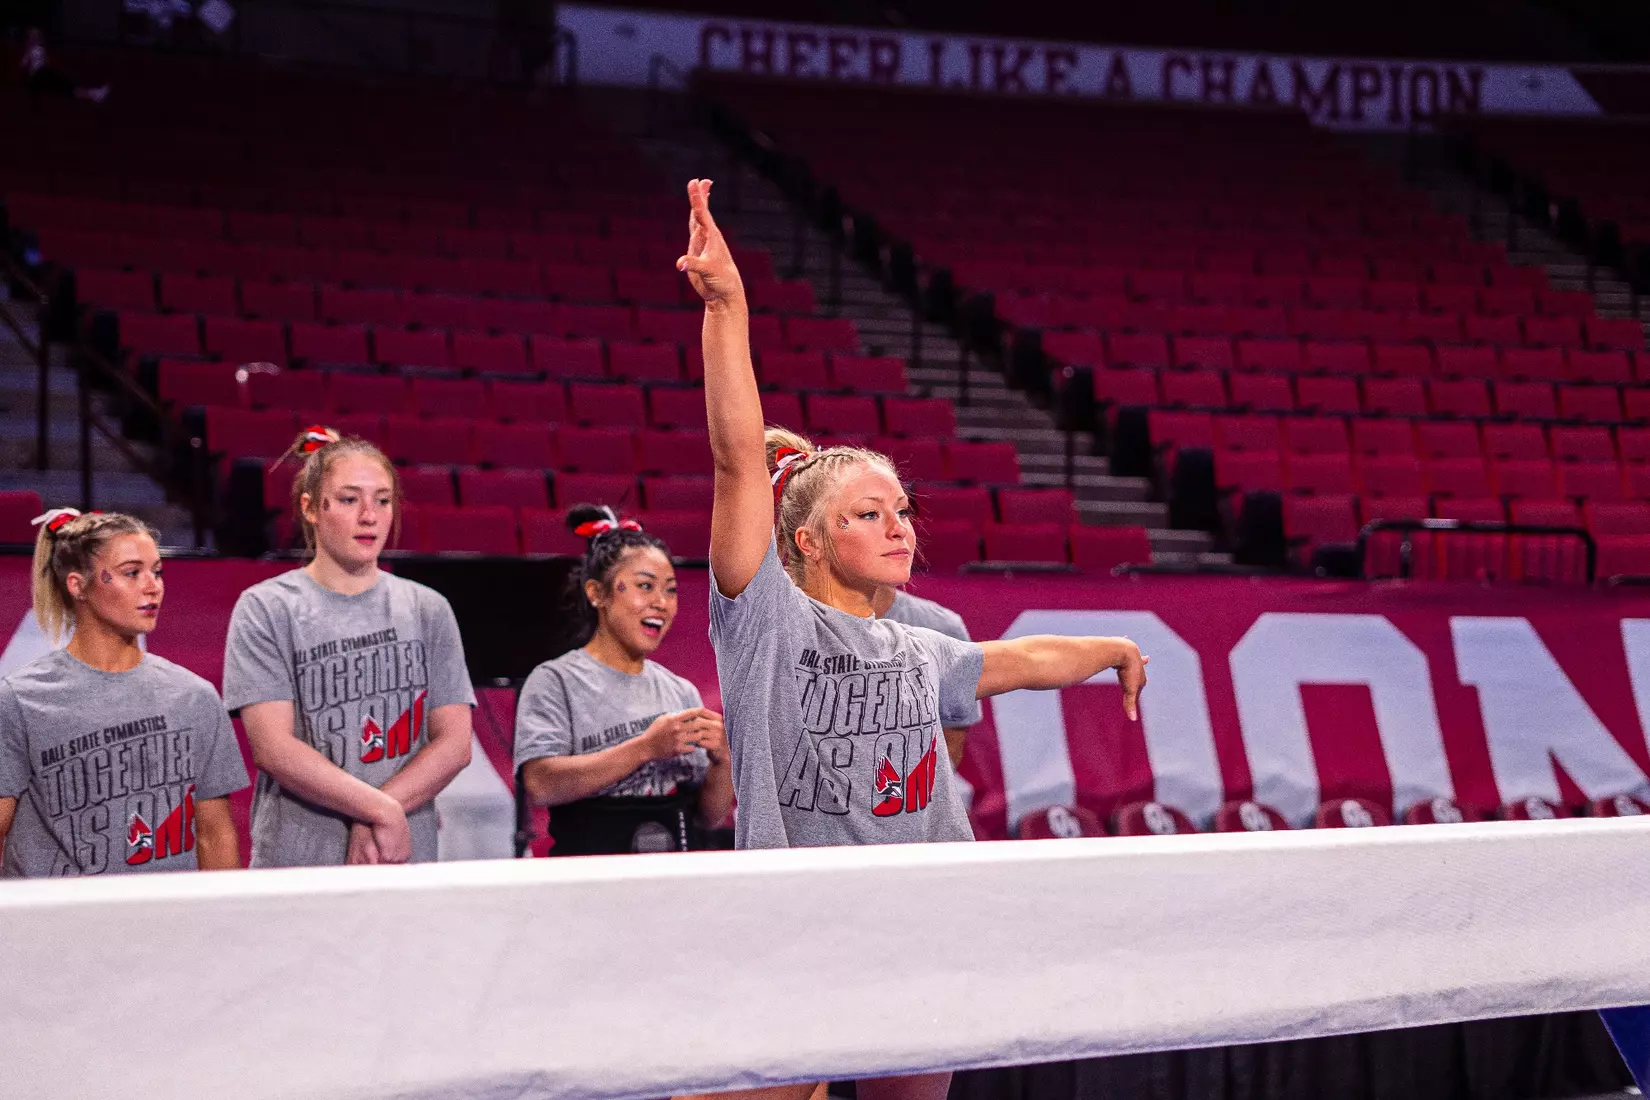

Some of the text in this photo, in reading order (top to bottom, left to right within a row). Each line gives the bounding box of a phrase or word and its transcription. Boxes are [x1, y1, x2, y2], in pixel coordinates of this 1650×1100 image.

[702, 24, 1482, 121] CHEER LIKE A CHAMPION
[310, 640, 338, 661] STATE
[341, 627, 398, 653] GYMNASTICS
[823, 654, 860, 675] STATE
[41, 714, 168, 768] BALL STATE GYMNASTICS
[953, 609, 1650, 834] OON
[41, 727, 197, 818] TOGETHER
[778, 727, 854, 816] AS
